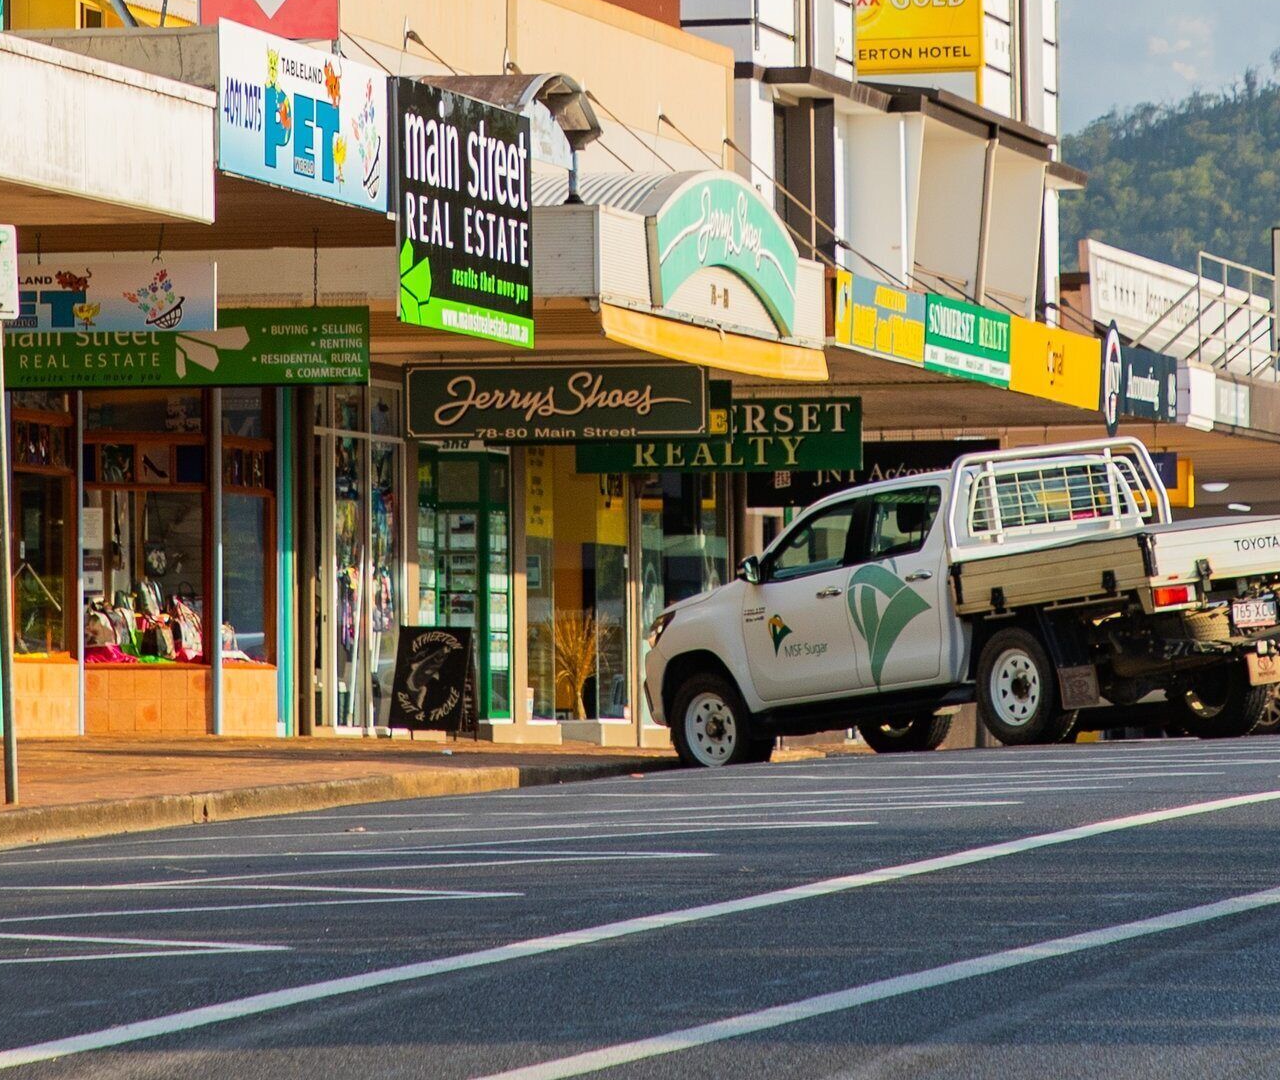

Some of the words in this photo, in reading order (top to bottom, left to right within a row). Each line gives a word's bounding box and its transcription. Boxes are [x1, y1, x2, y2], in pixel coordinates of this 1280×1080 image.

[858, 47, 913, 62] ERTON
[918, 45, 971, 59] HOTEL
[281, 57, 323, 85] TABLELAND
[265, 82, 340, 184] PET
[405, 100, 460, 192] main
[467, 119, 528, 211] street
[405, 191, 455, 249] REAL
[463, 206, 530, 268] ESTATE
[271, 324, 309, 335] BUYING
[321, 323, 363, 335] SELLING
[320, 338, 363, 349] RENTING
[20, 354, 70, 369] REAL
[84, 352, 161, 367] ESTATE
[261, 353, 328, 365] RESIDENTIAL,
[331, 352, 363, 363] RURAL
[285, 368, 294, 378] &
[297, 367, 363, 378] COMMERCIAL
[434, 375, 554, 426] Jerrys
[566, 371, 662, 416] Shoes
[476, 428, 527, 439] 78-80
[535, 427, 577, 438] Main
[583, 426, 638, 438] Street
[633, 435, 806, 467] REALTY
[1233, 535, 1280, 552] TOYOTA
[412, 631, 463, 653] ATHERTON
[784, 643, 802, 658] MSF
[804, 642, 828, 657] Sugar
[429, 686, 460, 722] TACKLE
